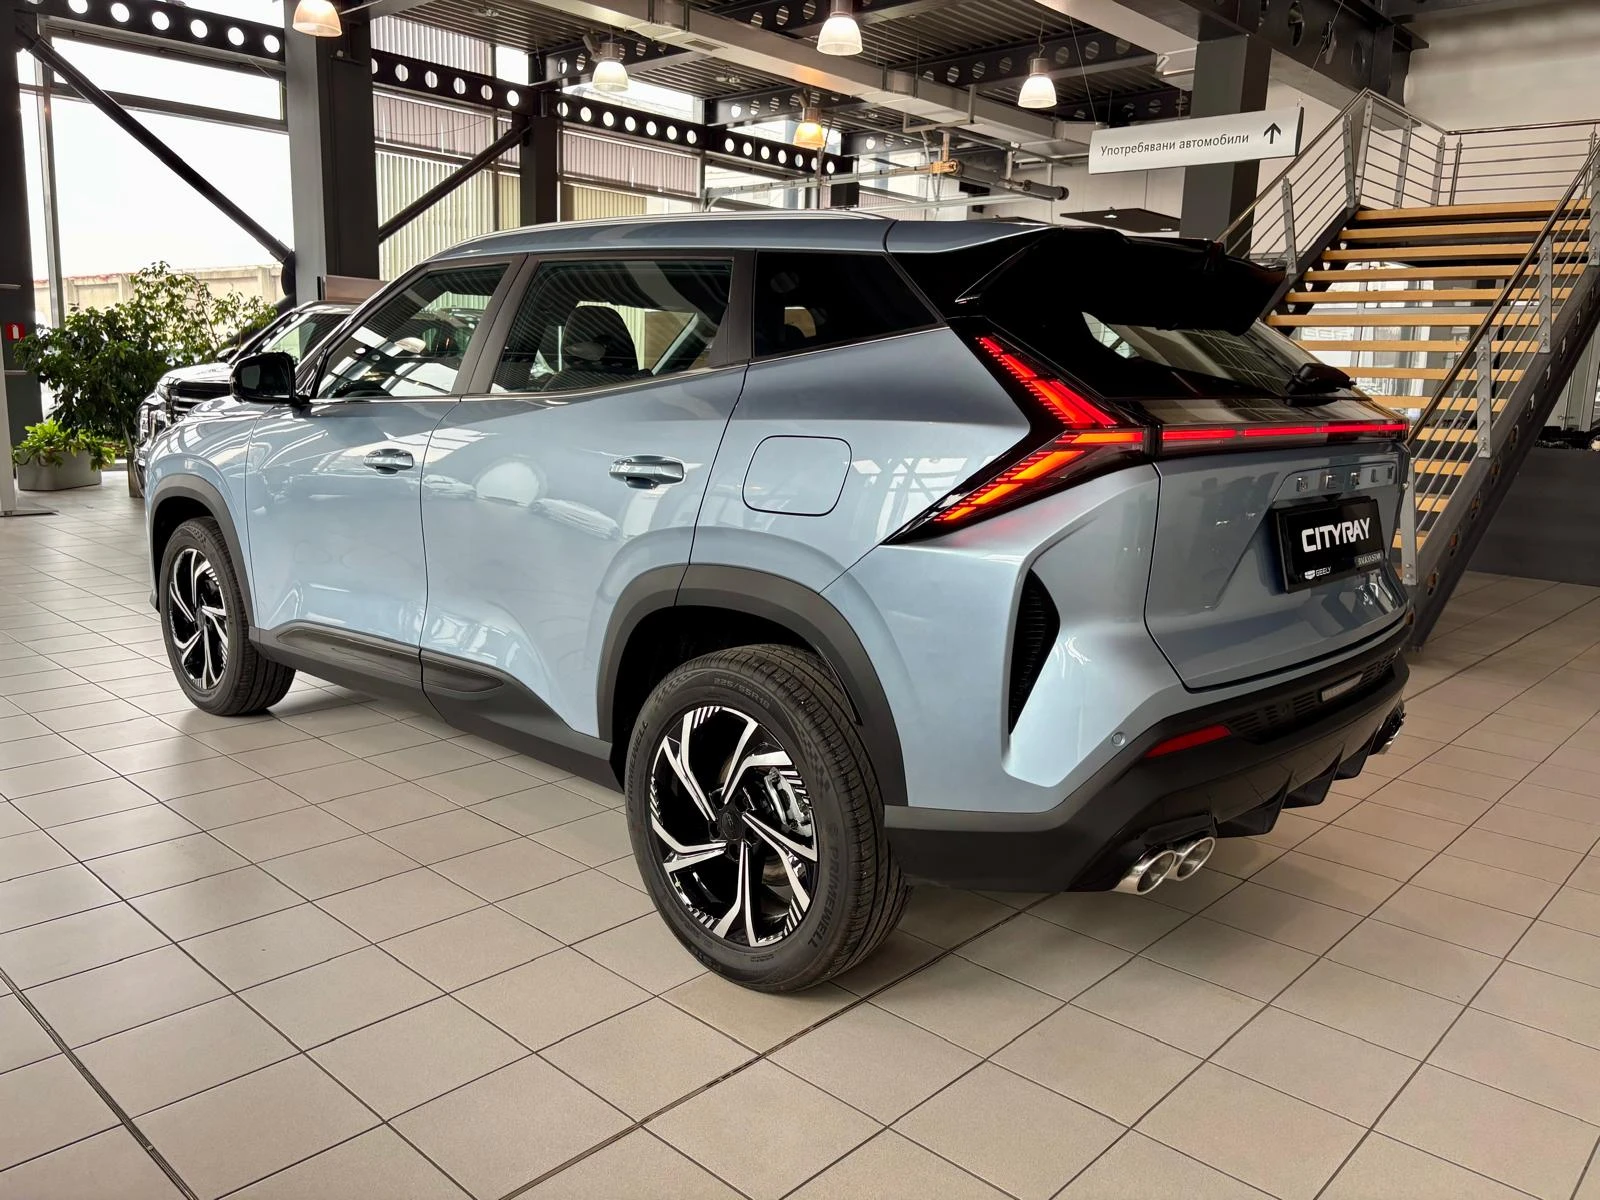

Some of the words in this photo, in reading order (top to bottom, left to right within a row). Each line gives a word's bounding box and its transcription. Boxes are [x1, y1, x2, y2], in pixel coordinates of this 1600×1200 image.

[1100, 141, 1176, 157] Употребявани
[1179, 133, 1250, 149] автомобили
[1301, 517, 1370, 553] CITYRAY
[1315, 566, 1331, 577] GEELY
[807, 848, 841, 949] PRIMEWELL
